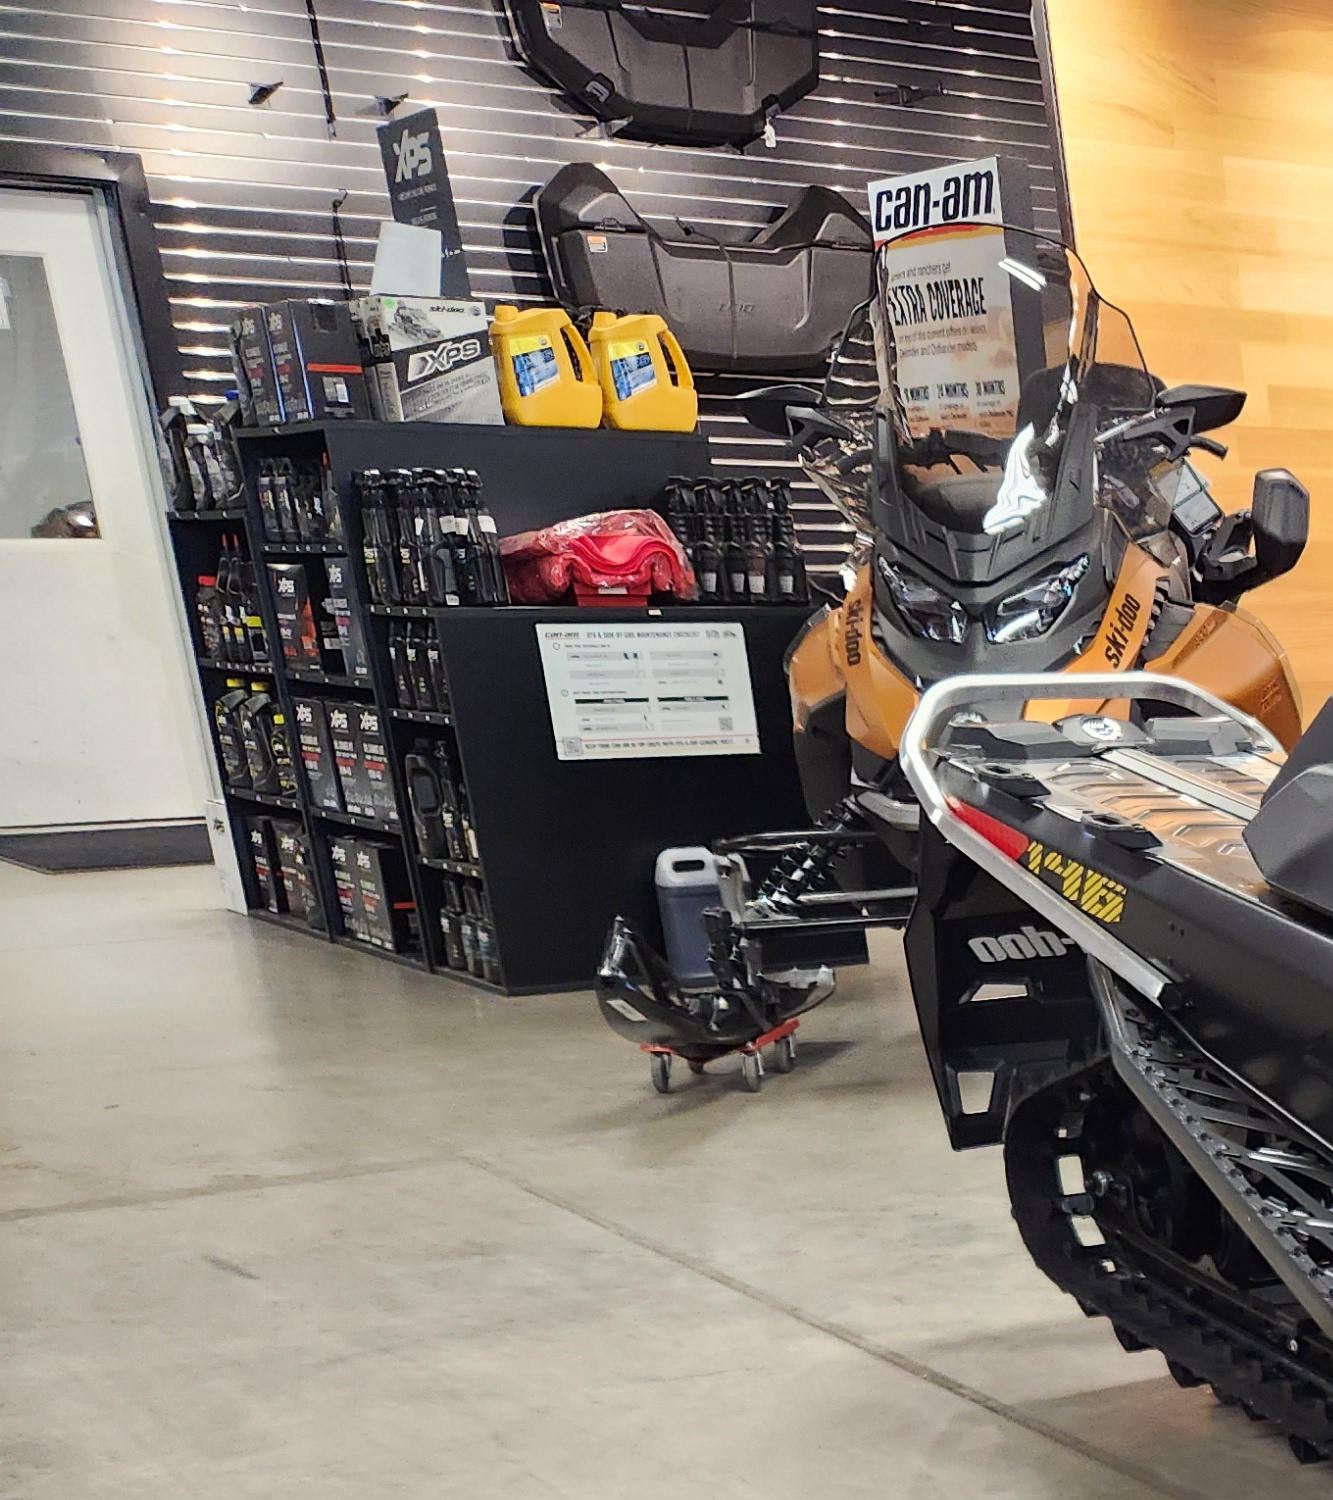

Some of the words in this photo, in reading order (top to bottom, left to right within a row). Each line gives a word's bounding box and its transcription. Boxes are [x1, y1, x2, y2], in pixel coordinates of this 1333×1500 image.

[393, 128, 433, 183] XPS
[875, 170, 995, 232] can-am
[888, 284, 928, 327] EXTRA
[926, 277, 987, 321] COVERAGE
[422, 339, 481, 373] XPS
[846, 598, 864, 667] ski-doo
[1105, 593, 1141, 669] ski-doo
[1027, 841, 1127, 923] 146
